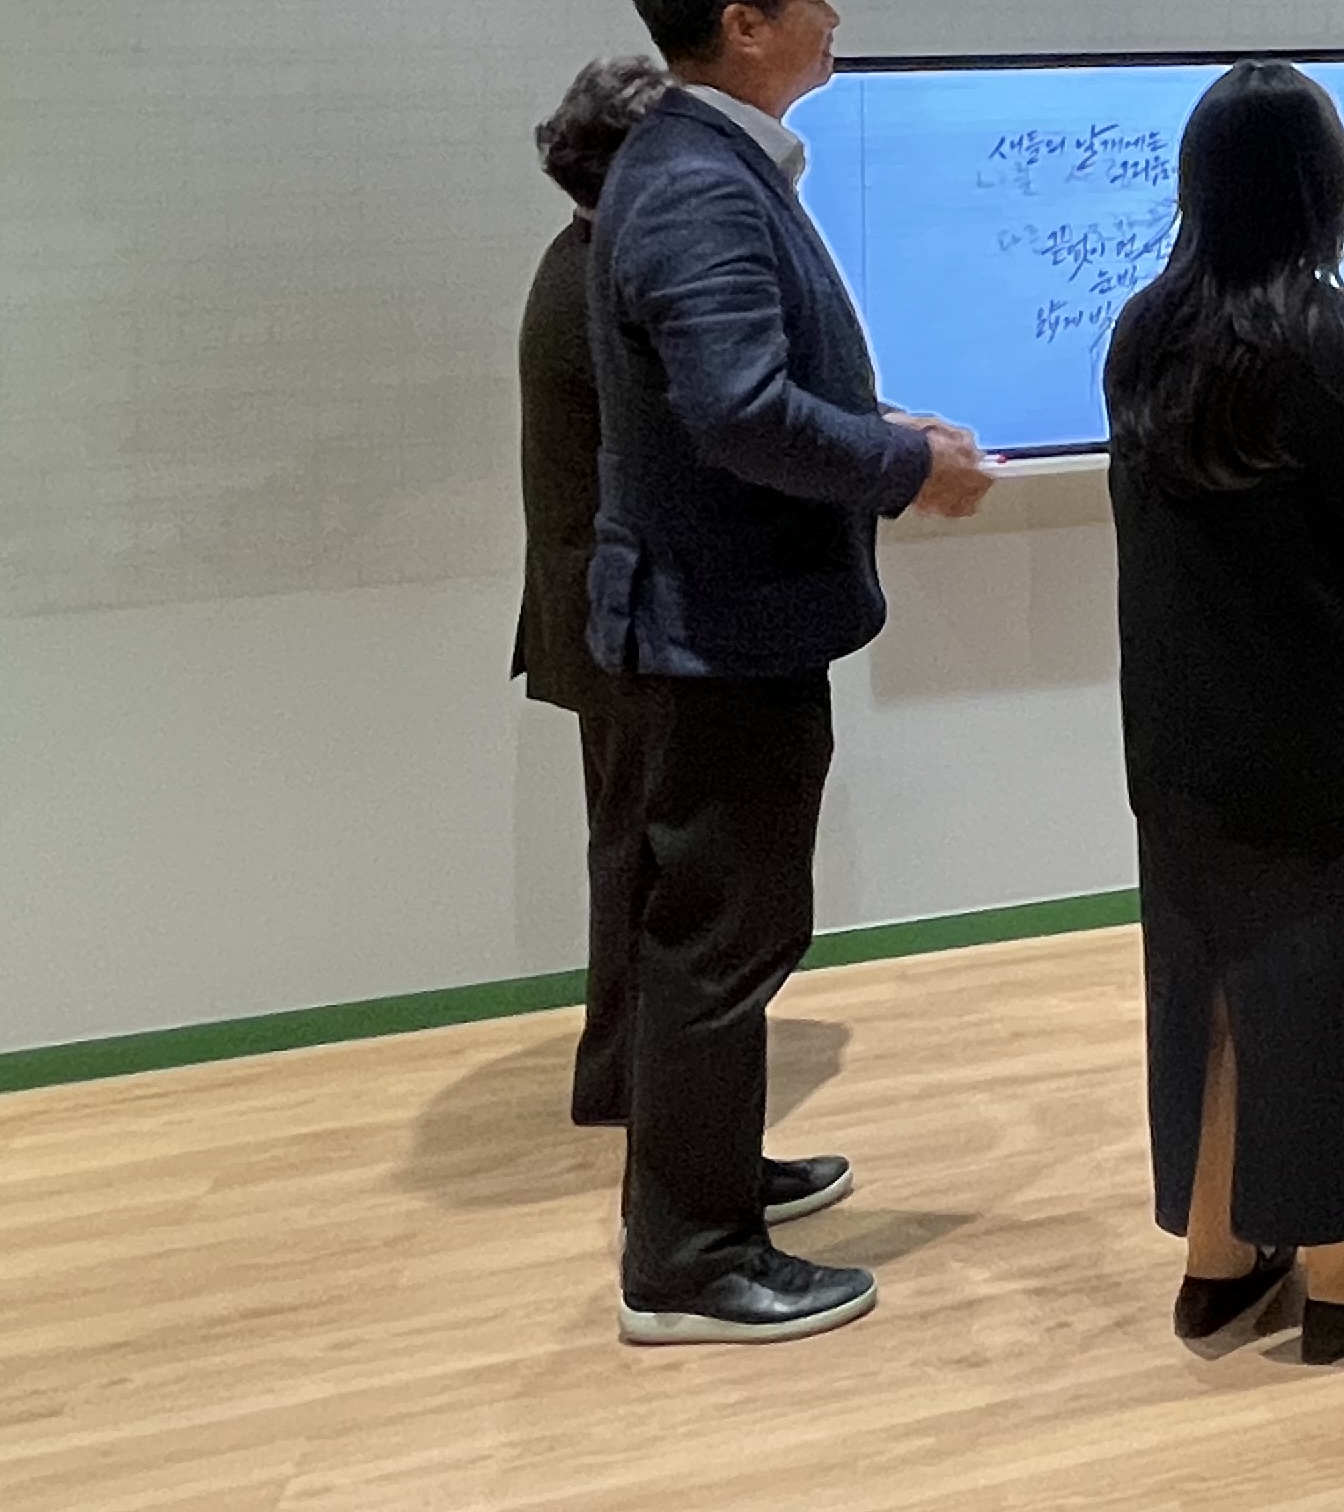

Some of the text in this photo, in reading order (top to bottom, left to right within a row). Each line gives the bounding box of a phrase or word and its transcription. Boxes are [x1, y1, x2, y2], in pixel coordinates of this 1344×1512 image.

[987, 123, 1168, 171] 새들의 날개에는
[1109, 154, 1177, 187] 그리움
